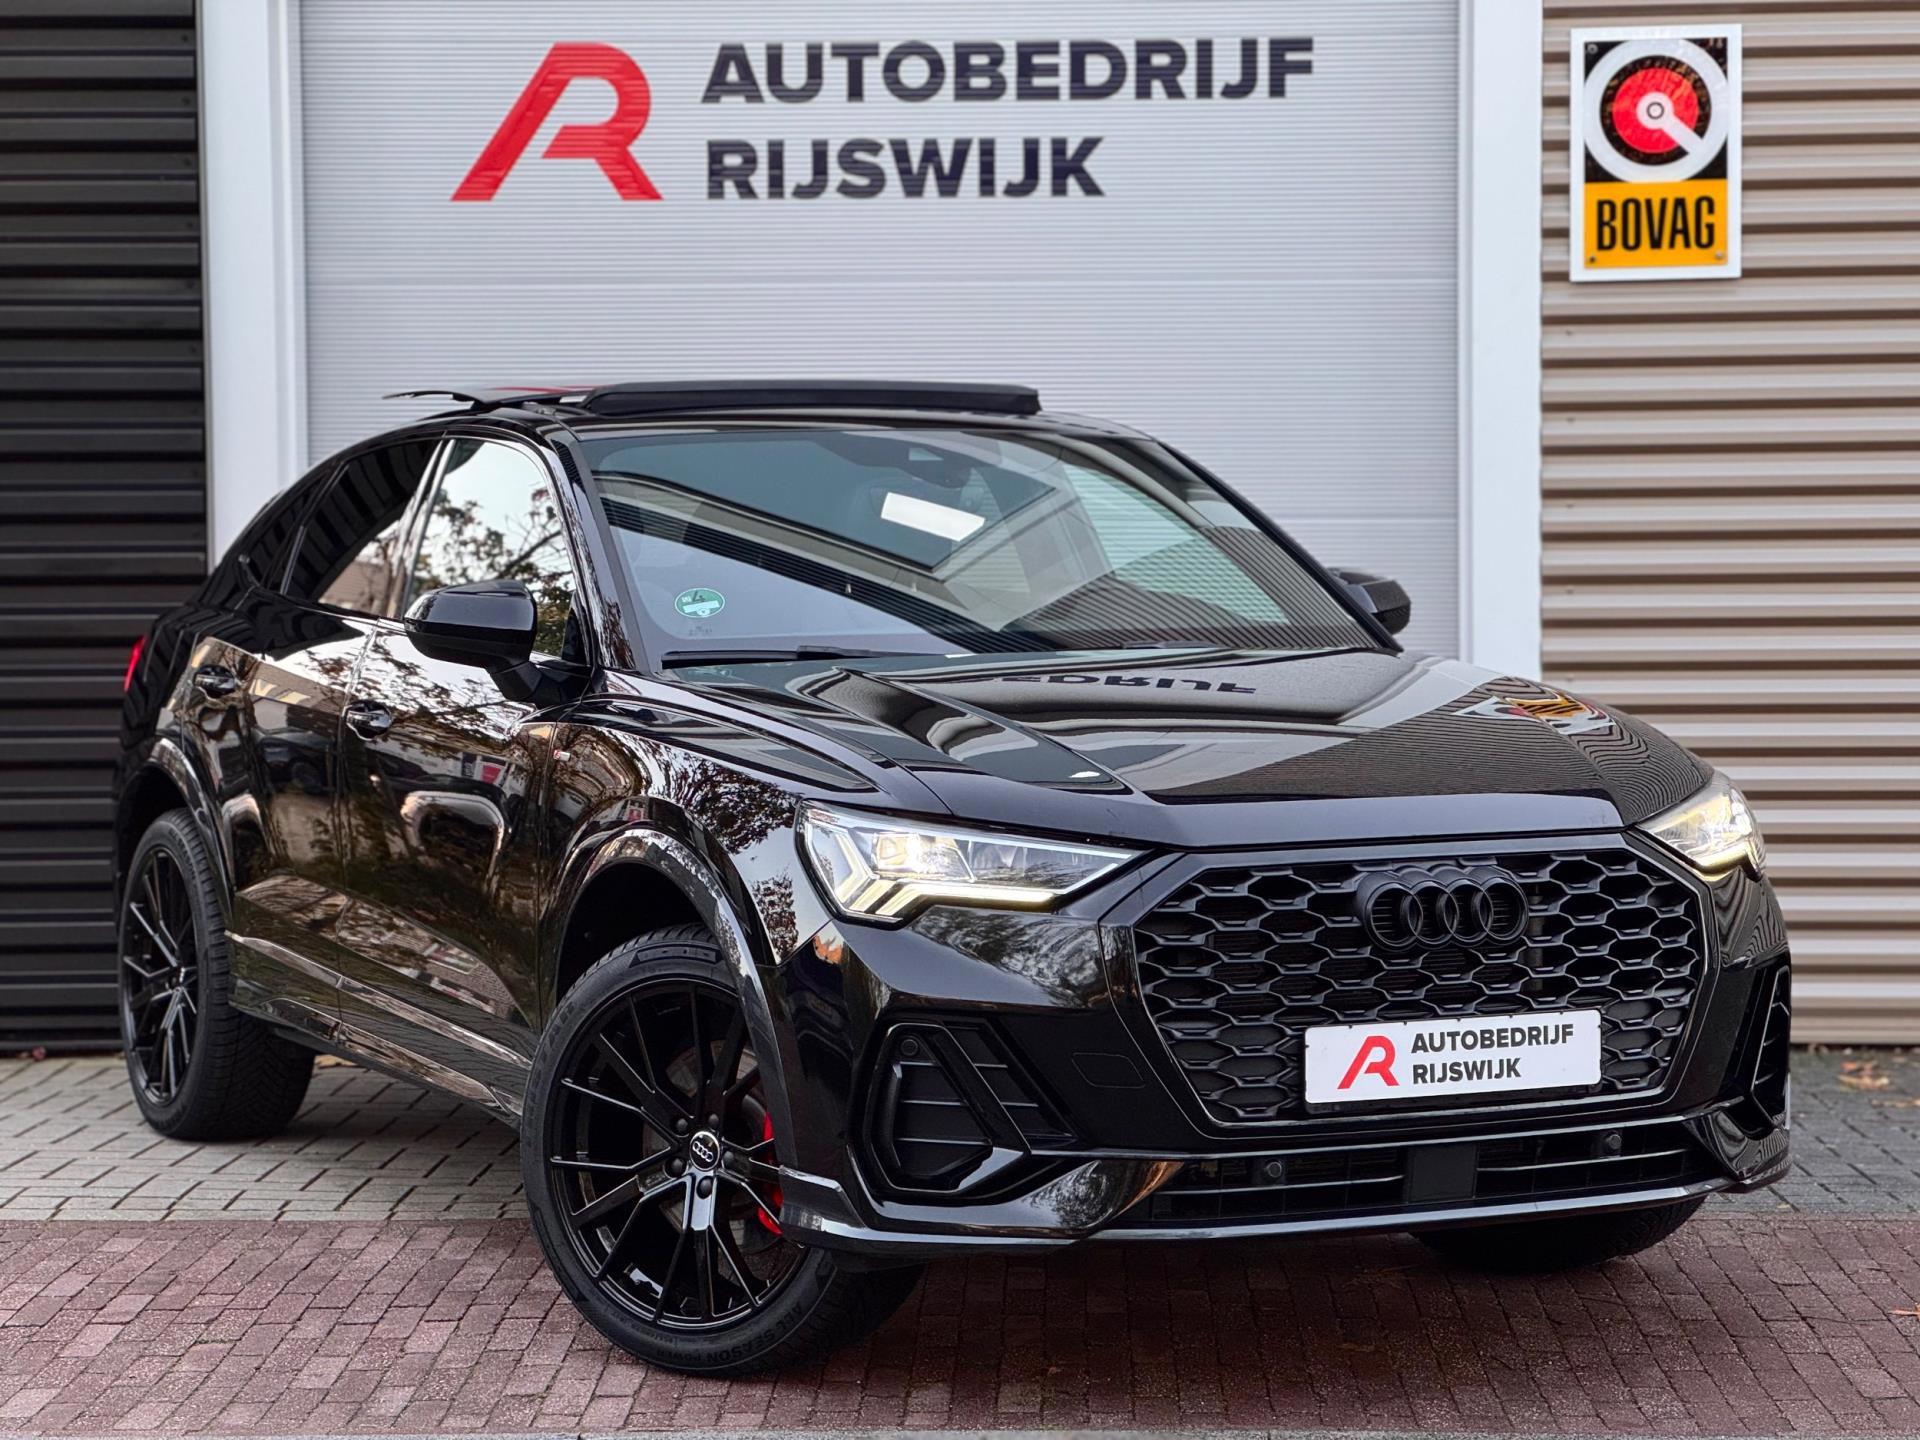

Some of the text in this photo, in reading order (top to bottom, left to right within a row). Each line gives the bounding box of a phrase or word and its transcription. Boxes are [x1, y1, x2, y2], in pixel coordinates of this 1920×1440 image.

[702, 37, 1313, 104] AUTOBEDRIJF
[707, 137, 1105, 199] RIJSWIJK
[1596, 195, 1715, 251] BOVAG
[1411, 1024, 1574, 1053] AUTOBEDRIJF
[1412, 1057, 1521, 1085] RIJSWIJK
[707, 1329, 776, 1363] SEASON
